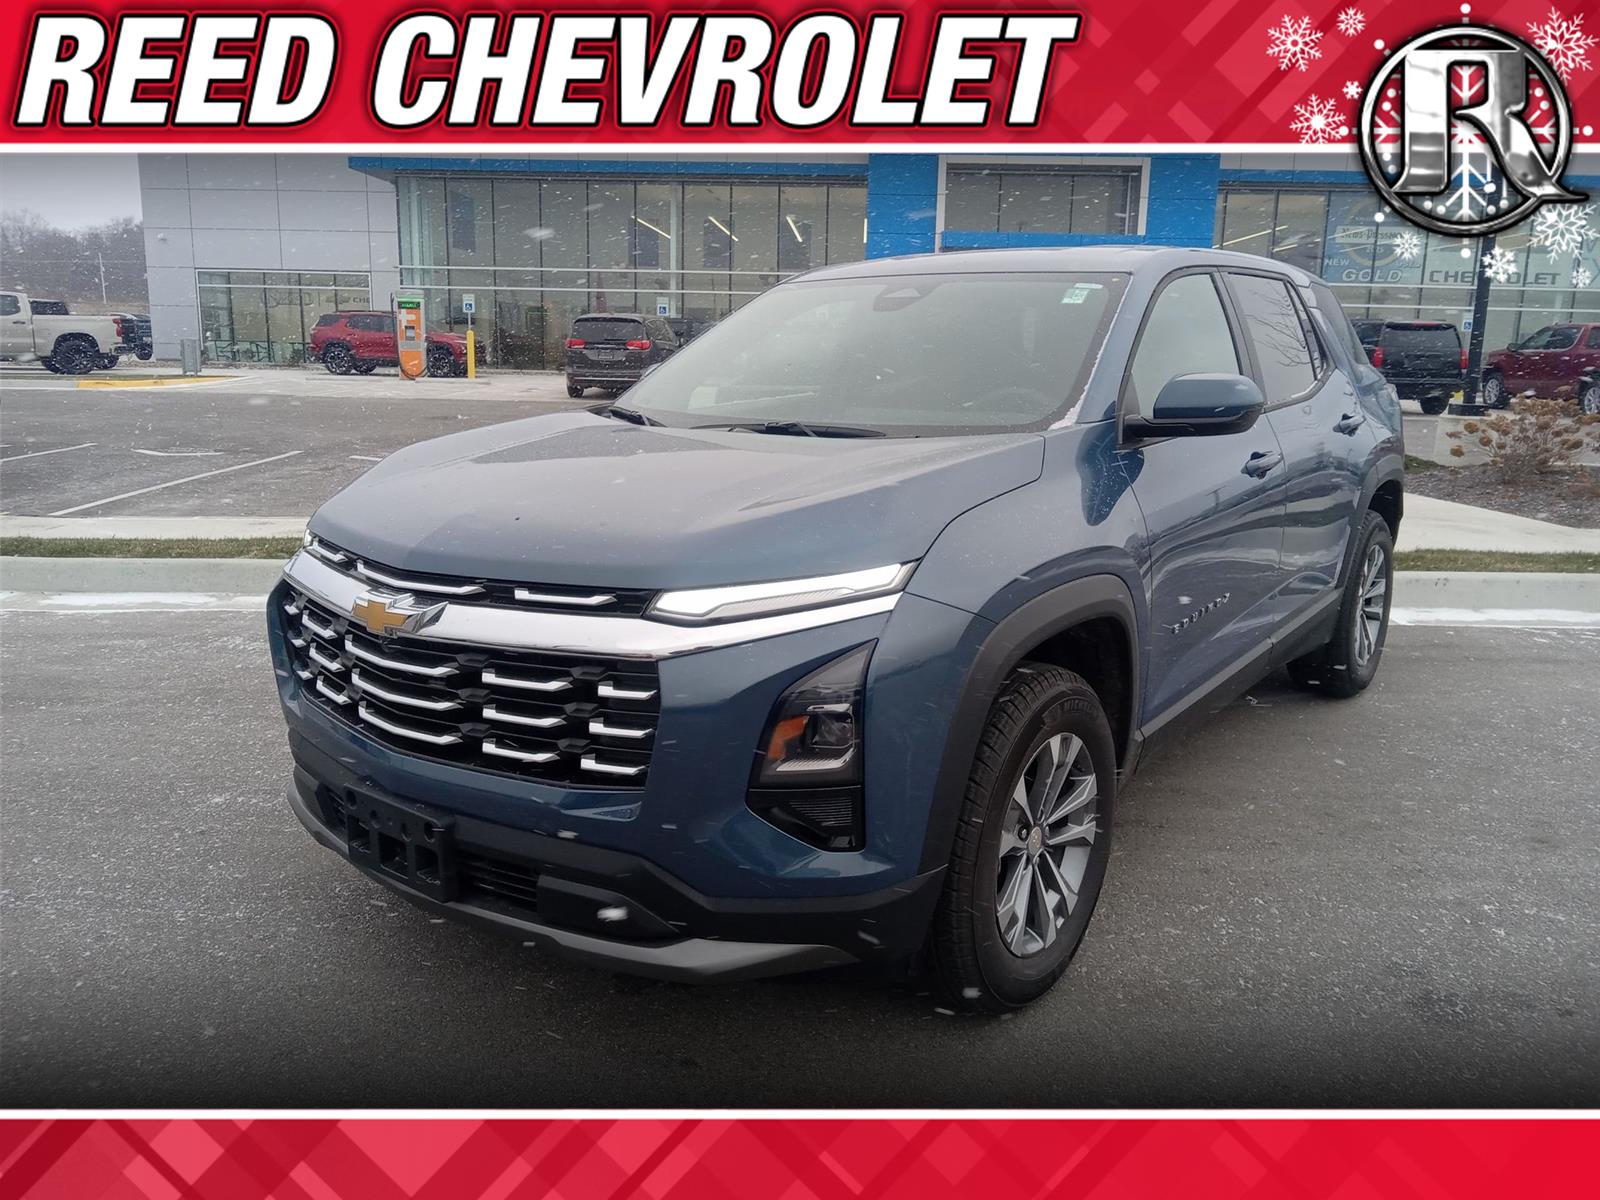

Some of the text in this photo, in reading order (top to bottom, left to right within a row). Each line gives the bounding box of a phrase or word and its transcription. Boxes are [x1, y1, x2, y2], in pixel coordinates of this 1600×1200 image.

[1325, 258, 1350, 267] NEW
[1342, 268, 1403, 282] GOLD
[1429, 270, 1561, 285] CHEOLET
